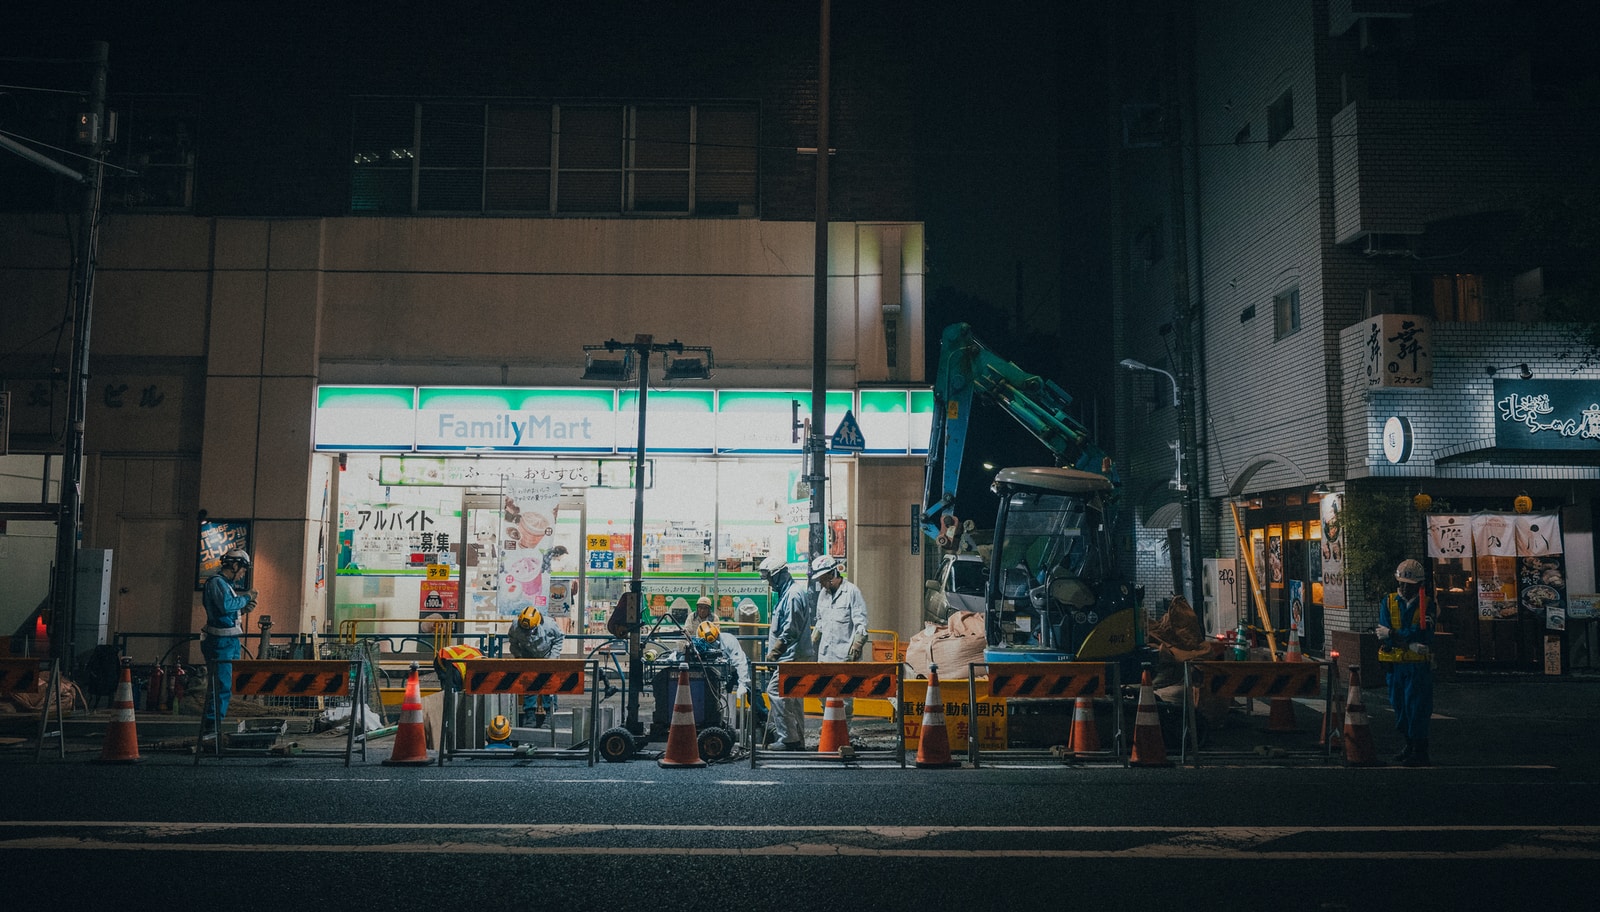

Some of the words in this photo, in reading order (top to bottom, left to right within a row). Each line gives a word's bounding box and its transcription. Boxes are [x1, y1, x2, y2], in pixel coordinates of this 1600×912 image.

[1394, 376, 1423, 384] スナック
[439, 413, 592, 446] FamilyMart
[358, 510, 434, 532] アルバイト
[421, 532, 450, 553] 募集
[590, 538, 607, 547] 予告
[430, 568, 447, 577] 予告
[903, 702, 1005, 717] 重機動範囲内
[903, 720, 1003, 741] 立禁止
